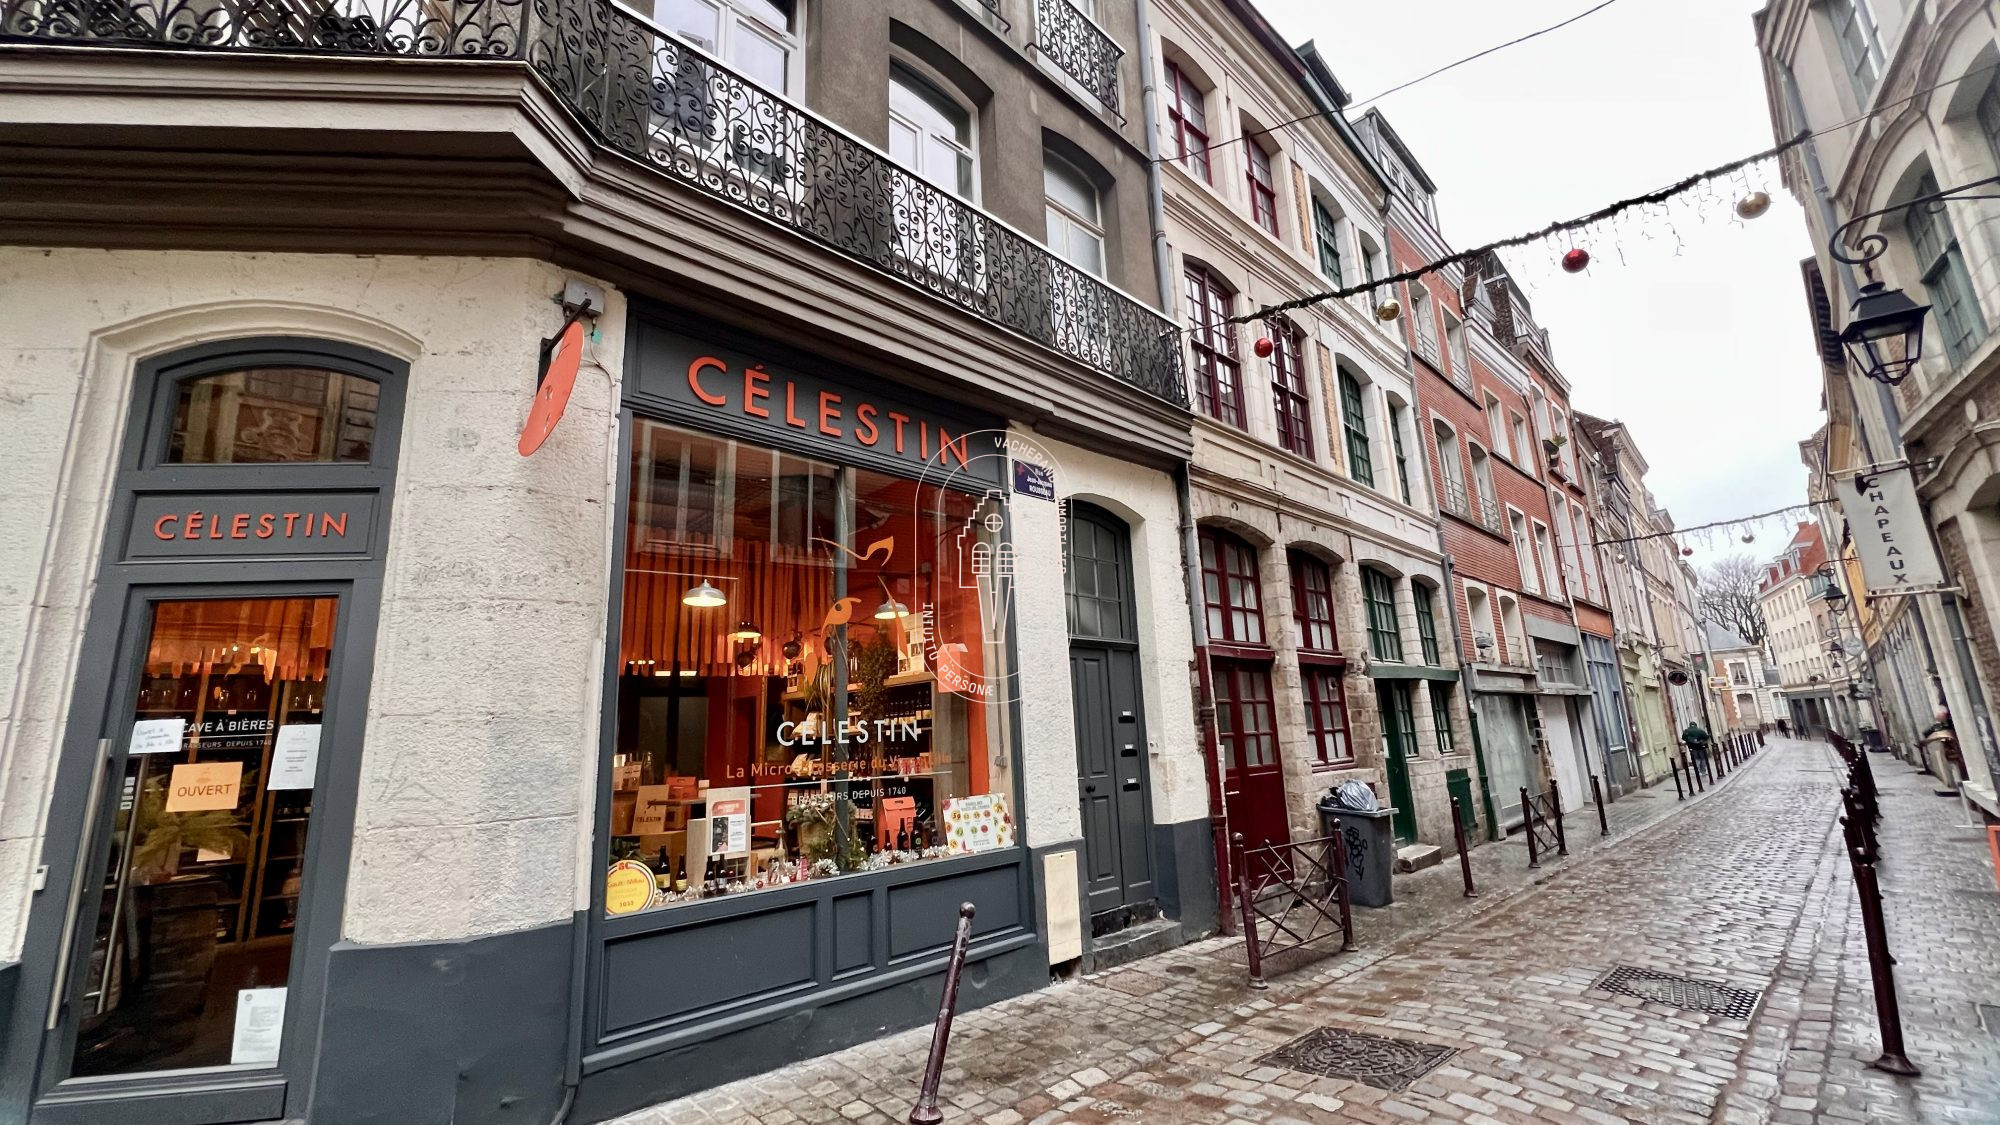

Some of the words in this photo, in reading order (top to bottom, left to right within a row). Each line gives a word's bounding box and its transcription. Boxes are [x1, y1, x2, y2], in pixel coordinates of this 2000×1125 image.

[687, 355, 969, 473] CÉLESTIN
[152, 510, 348, 540] CÉLESTIN
[1865, 477, 1909, 585] CHAPEAUX
[216, 718, 226, 732] À
[229, 717, 274, 731] BIÈRES
[225, 739, 254, 748] DEPUIS
[725, 763, 745, 779] La
[177, 783, 233, 797] OUVERT
[852, 788, 885, 800] DEPUIS
[888, 786, 907, 796] 1740
